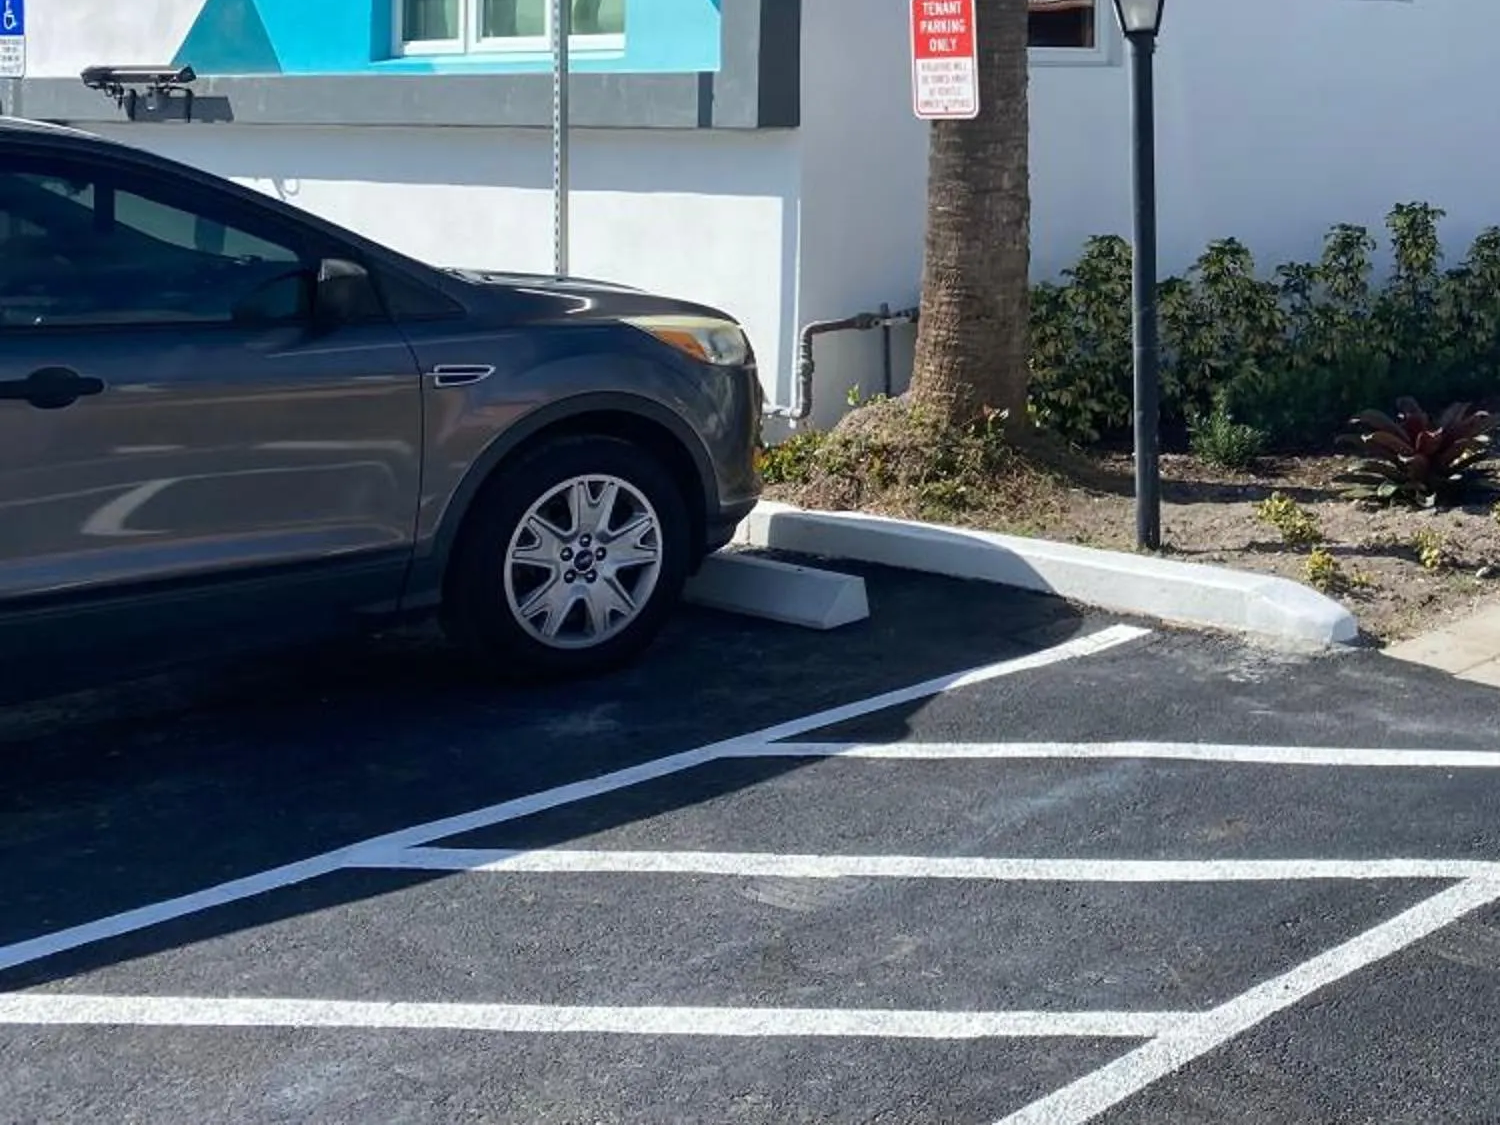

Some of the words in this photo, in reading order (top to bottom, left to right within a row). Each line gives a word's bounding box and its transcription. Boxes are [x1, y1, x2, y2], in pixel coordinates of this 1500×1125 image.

[922, 0, 962, 16] TENANT
[920, 18, 966, 33] PARKING
[928, 37, 957, 52] ONLY
